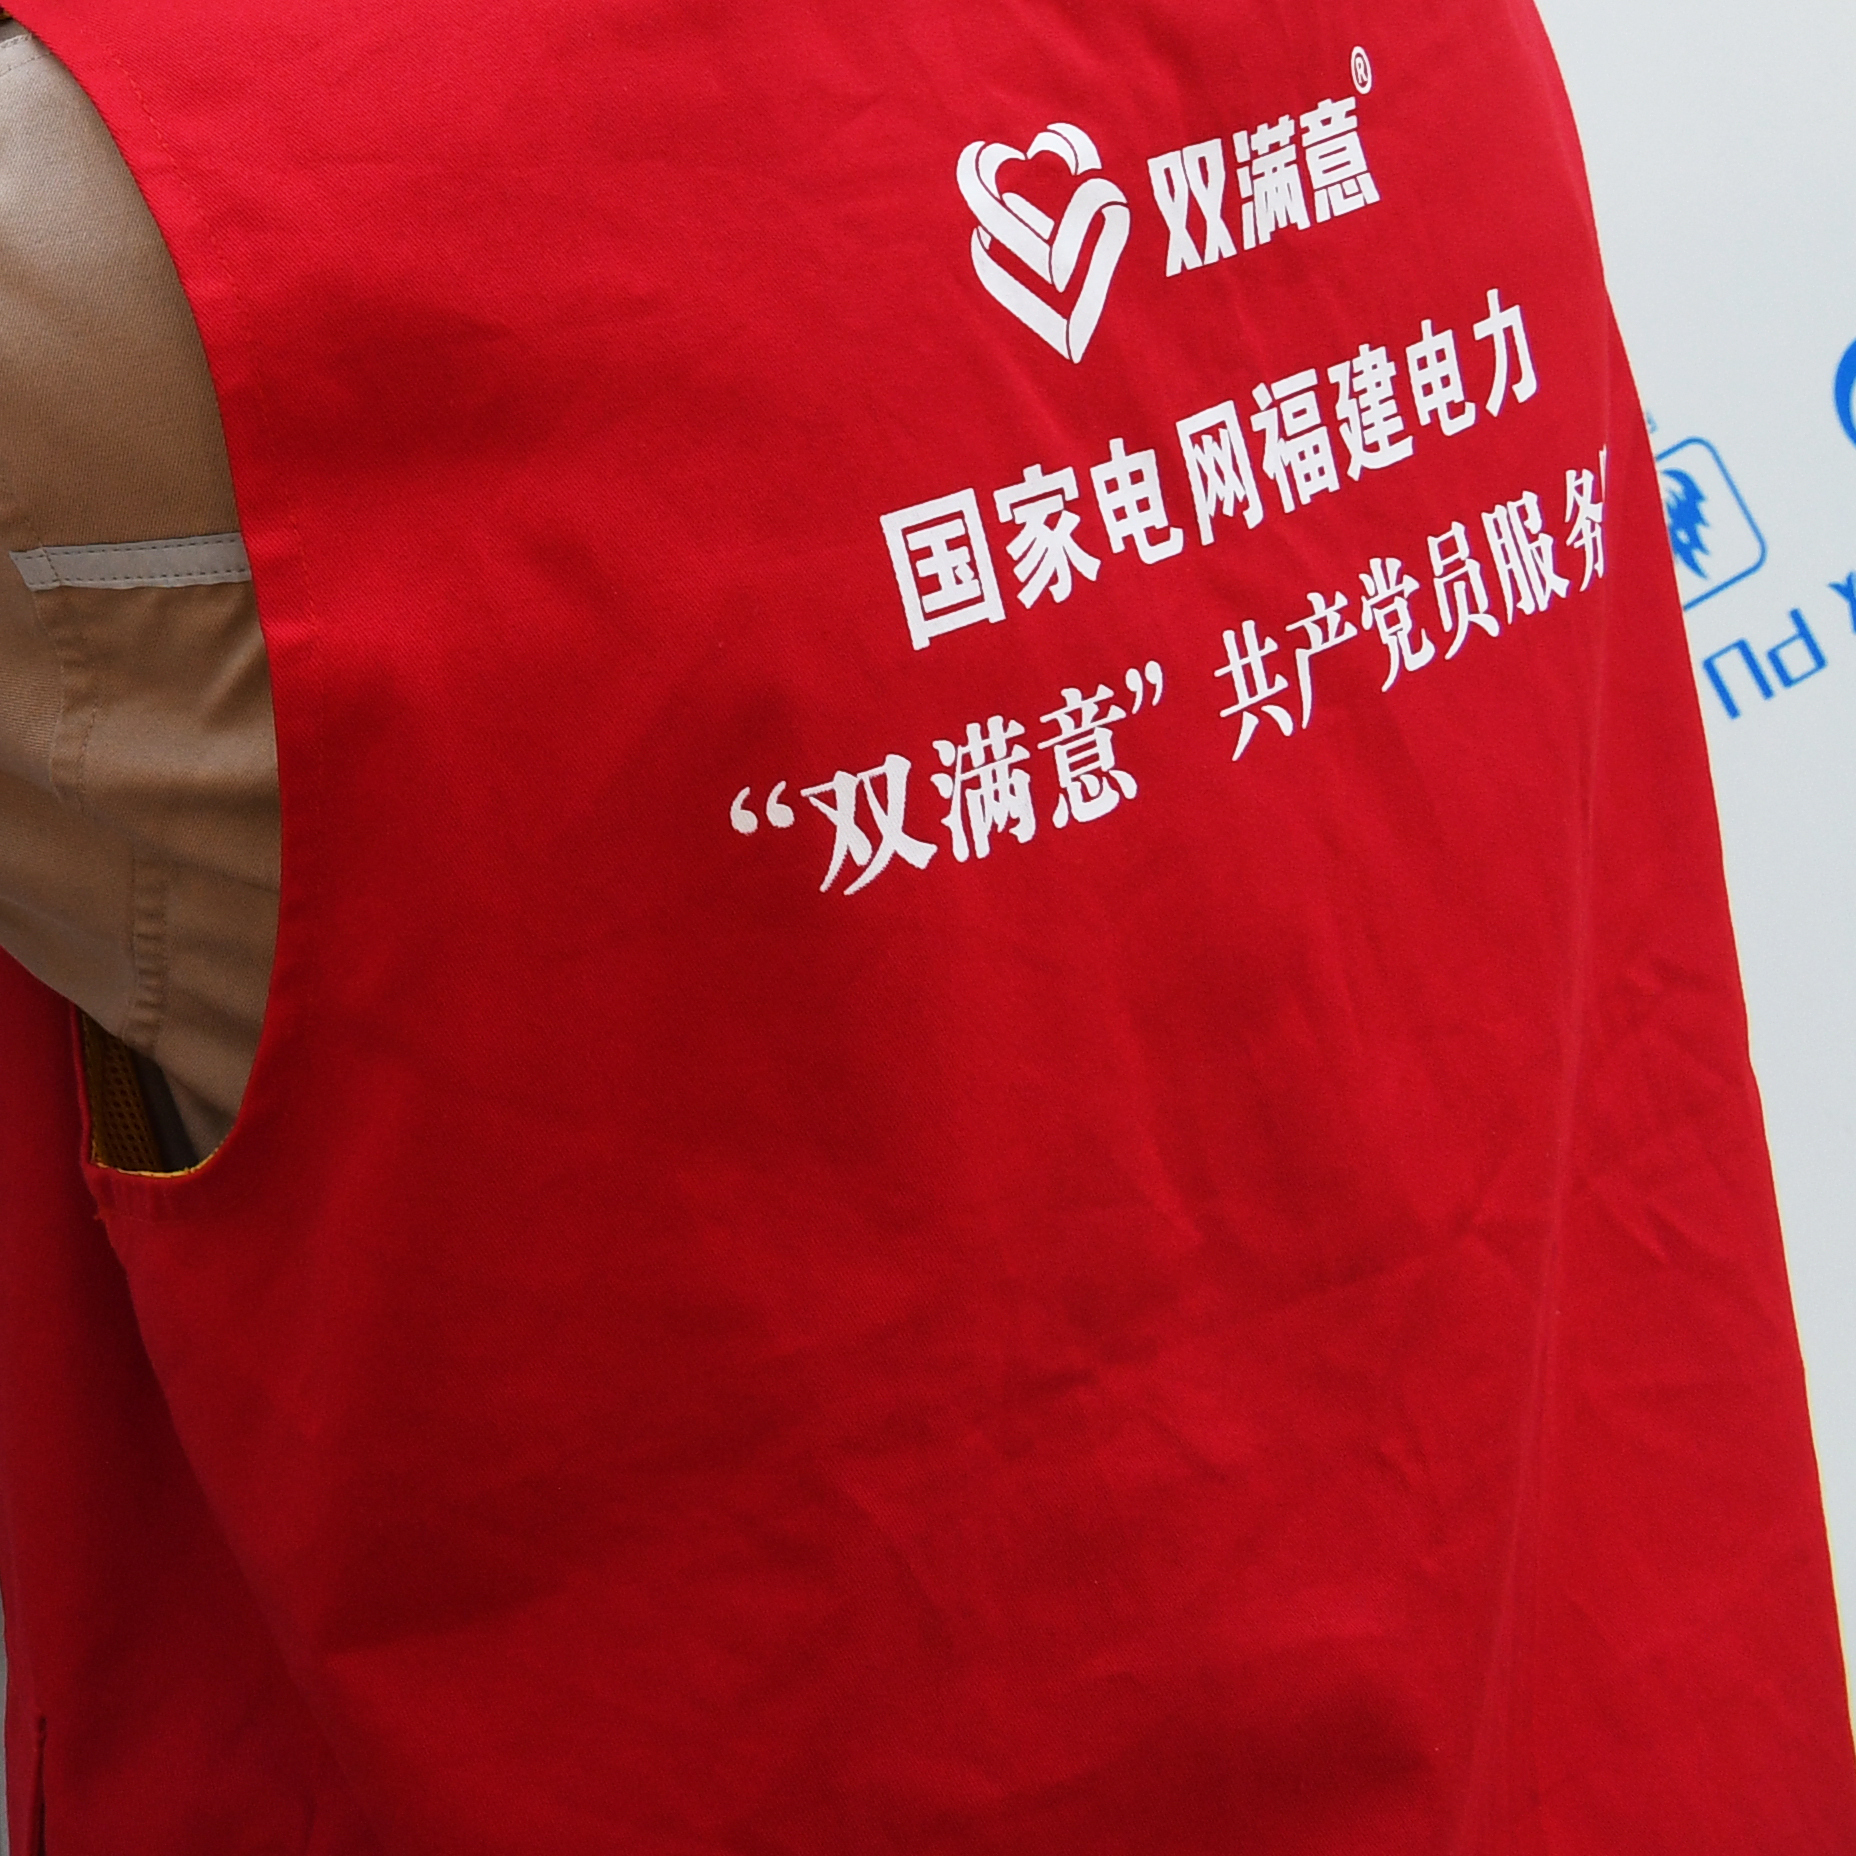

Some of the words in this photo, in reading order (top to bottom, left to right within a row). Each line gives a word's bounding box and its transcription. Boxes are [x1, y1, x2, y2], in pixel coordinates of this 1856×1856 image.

[880, 288, 1539, 651] 国家电网福建电力
[1213, 443, 1607, 761] 共产党员服务
[1703, 608, 1827, 720] PU
